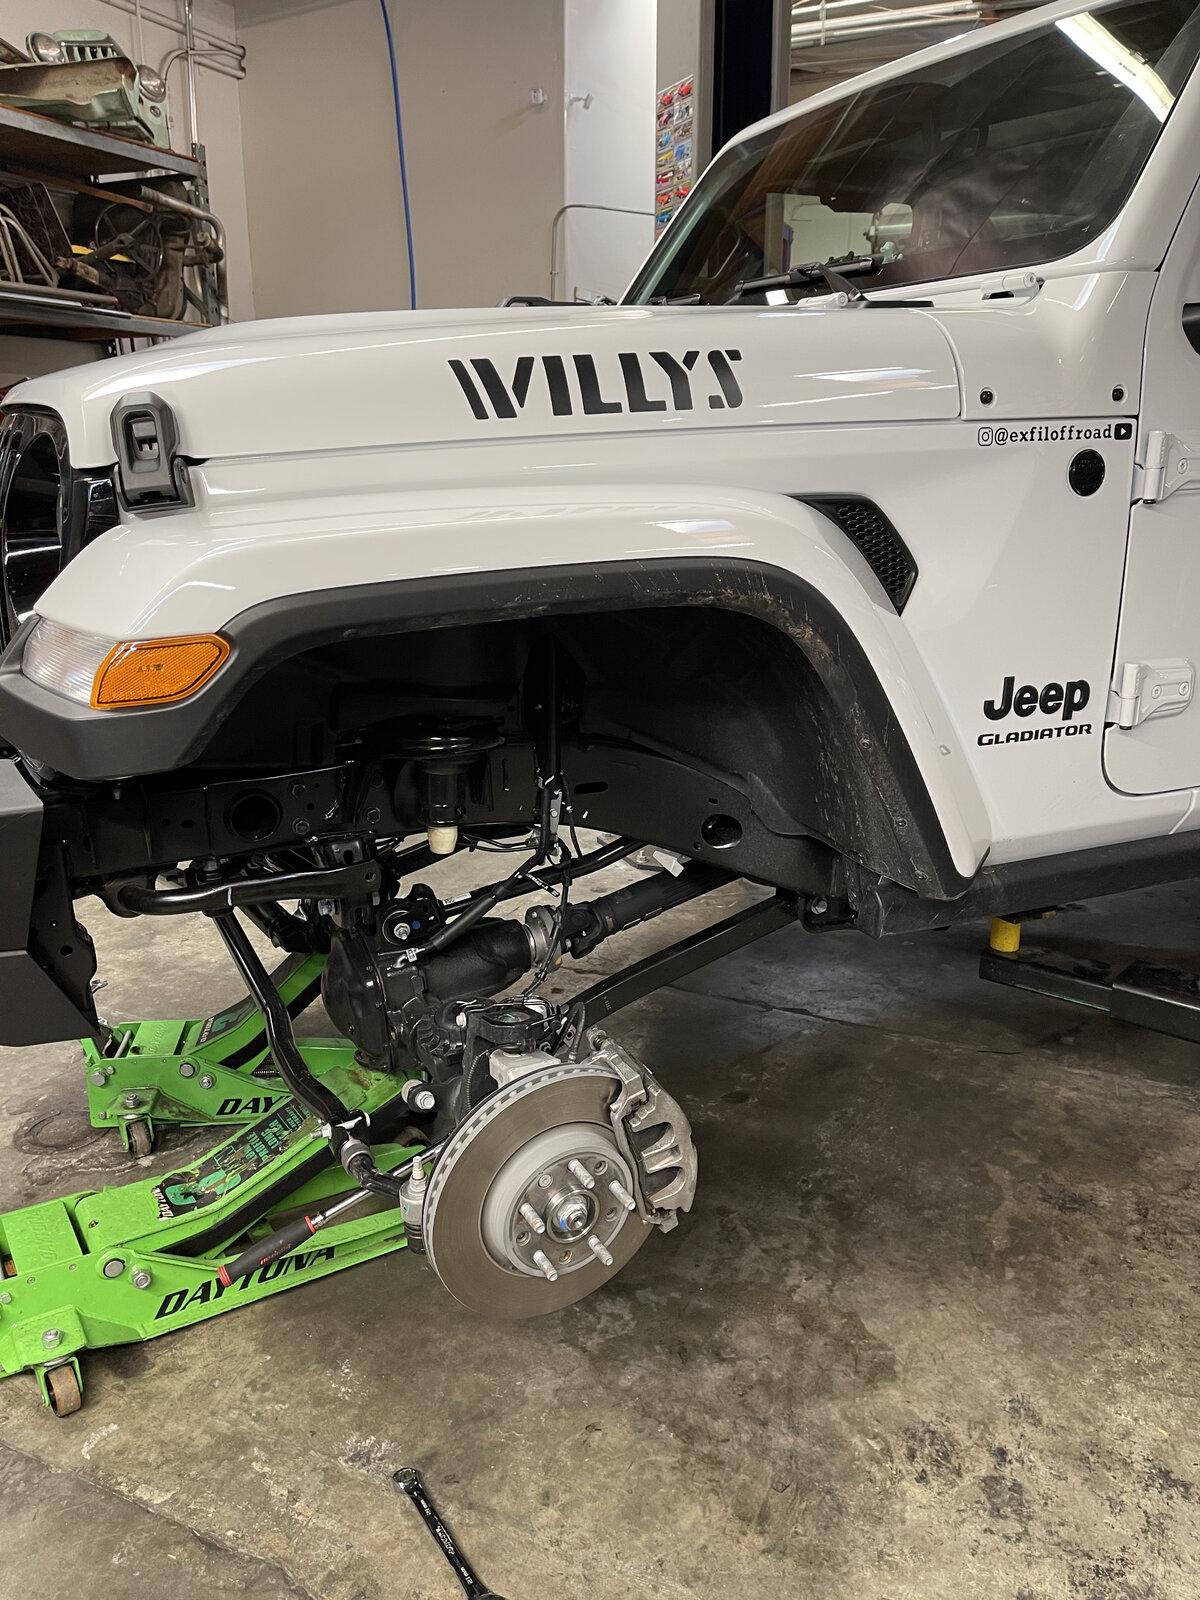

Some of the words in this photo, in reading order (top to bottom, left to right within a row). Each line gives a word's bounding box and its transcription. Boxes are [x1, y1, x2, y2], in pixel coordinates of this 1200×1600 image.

[447, 350, 743, 420] WILLYS
[994, 424, 1112, 445] @exfiloffroad
[984, 676, 1090, 721] Jeep
[977, 724, 1092, 746] GLADIATOR
[216, 1096, 291, 1115] DAY
